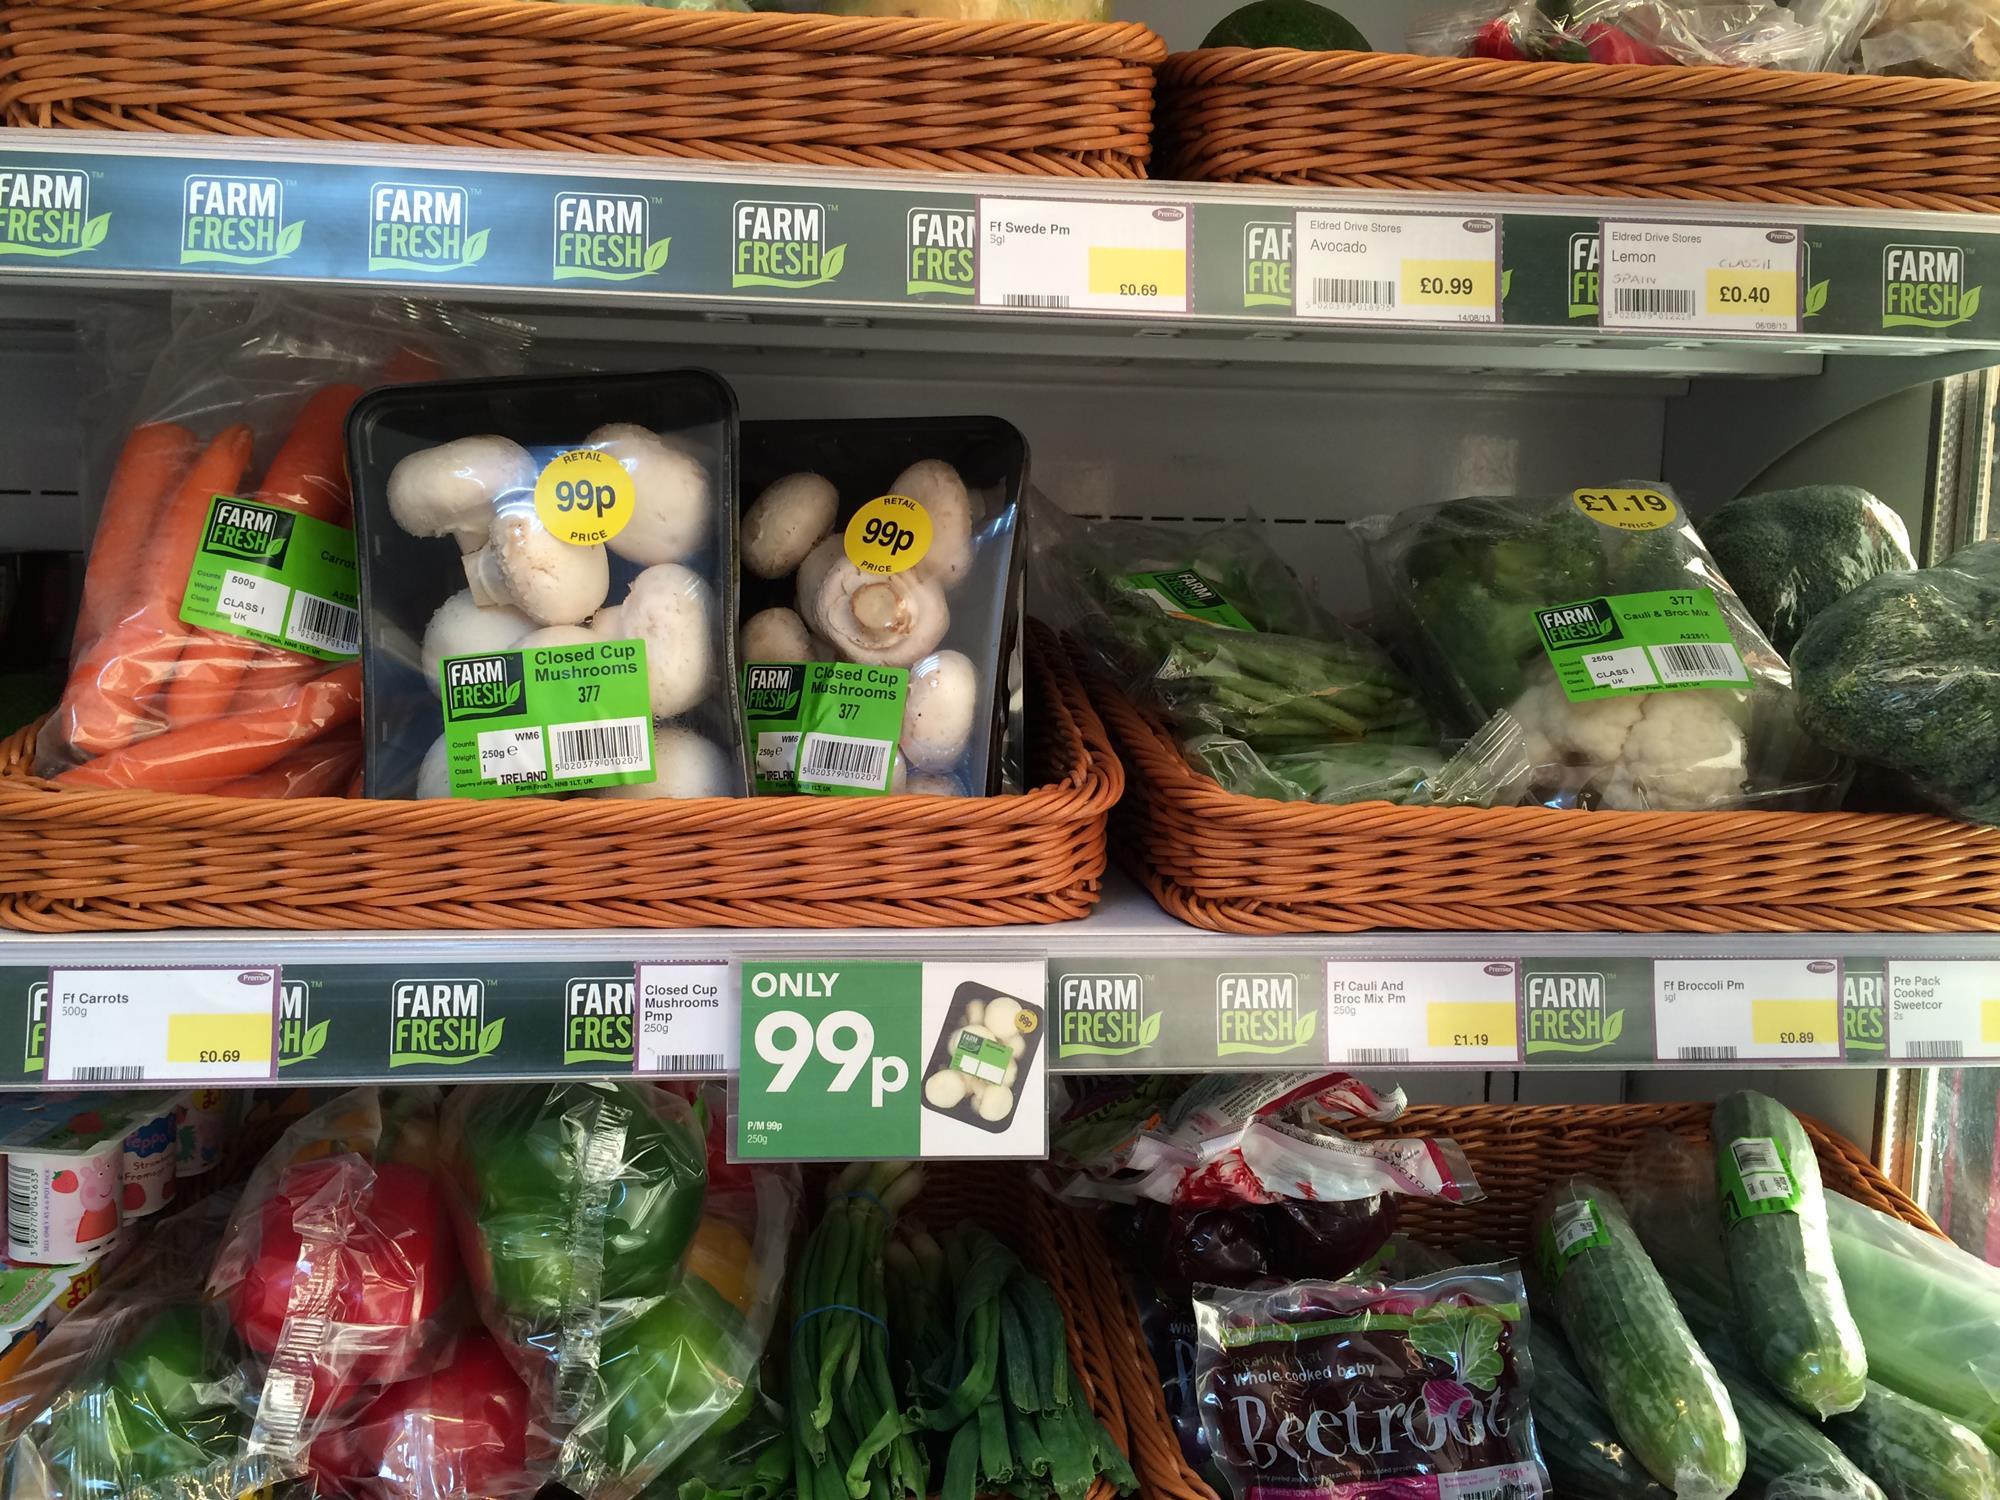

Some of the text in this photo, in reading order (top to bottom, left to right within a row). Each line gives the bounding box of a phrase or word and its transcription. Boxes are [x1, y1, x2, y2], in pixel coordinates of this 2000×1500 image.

[0, 173, 83, 210] FARM
[189, 180, 276, 217] FARM
[375, 188, 461, 225] FARM
[559, 198, 642, 234] FARM
[738, 206, 818, 242] FARM
[0, 208, 80, 244] FRESH
[187, 216, 274, 252] FRESH
[990, 221, 1070, 235] Ff Swede Pm
[1310, 220, 1402, 234] Eldred Drive Stores
[374, 225, 461, 260] FRESH
[989, 234, 1006, 246] Sgl
[1612, 231, 1702, 244] Eldred Drive Stores
[558, 233, 642, 268] FRESH
[1310, 238, 1367, 254] Avocado
[737, 241, 818, 276] FRESH
[911, 247, 974, 282] FRES
[1612, 250, 1656, 263] Lemon
[1887, 250, 1959, 283] FARM
[1119, 283, 1158, 297] £0.69
[1419, 277, 1473, 295] £0.99
[1719, 286, 1770, 303] £0.40
[1886, 283, 1958, 316] FRESH
[563, 451, 603, 464] RETAIL
[555, 479, 616, 518] 99p
[883, 497, 917, 512] RETAIL
[1578, 494, 1668, 512] £1.19
[217, 505, 273, 533] FARM
[1618, 521, 1656, 530] PRICE
[212, 524, 269, 552] FRESH
[570, 529, 608, 543] PRICE
[861, 517, 915, 555] 99p
[860, 559, 893, 573] PRICE
[231, 575, 256, 590] 500g
[1178, 574, 1212, 598] FARM
[223, 597, 259, 613] CLASS
[1669, 596, 1694, 606] 377
[233, 611, 248, 621] UK
[1543, 606, 1593, 629] FARM
[1623, 608, 1711, 621] Cauli & Broc Mix
[1549, 622, 1600, 643] FRESH
[535, 644, 635, 666] Closed Cup
[1592, 655, 1614, 664] 250g
[451, 659, 503, 687] FARM
[535, 661, 638, 682] Mushrooms
[751, 669, 790, 689] FARM
[814, 666, 898, 687] Closed Cup
[1596, 669, 1629, 679] CLASS
[1612, 677, 1625, 685] UK
[453, 681, 505, 708] FRESH
[578, 684, 601, 703] 377
[748, 689, 789, 708] FRESH
[811, 681, 897, 700] Mushrooms
[838, 703, 860, 720] 377
[452, 739, 476, 749] Counts
[515, 731, 540, 742] WM6
[781, 735, 799, 743] WM6
[453, 753, 476, 762] Weight
[482, 749, 505, 760] 250g
[759, 748, 775, 758] 250g
[454, 767, 473, 775] Class
[564, 760, 600, 771] 020379
[604, 757, 639, 766] 010207
[500, 770, 548, 785] IRELAND
[810, 768, 841, 777] 020379
[845, 772, 877, 781] 010207
[242, 973, 271, 982] Premier
[751, 972, 840, 998] ONLY
[1894, 976, 1941, 986] Pre Pack
[645, 984, 718, 998] Closed Cup
[1221, 978, 1292, 1009] FARM
[1334, 980, 1404, 992] Ff Cauli And
[1529, 978, 1599, 1008] FARM
[1664, 981, 1744, 991] Ff Broccoli Pm
[1894, 988, 1934, 998] Cooked
[62, 992, 129, 1004] Ff Carrots
[397, 984, 478, 1018] FARM
[1063, 979, 1137, 1010] FARM
[1334, 993, 1406, 1004] Broc Mix Pm
[645, 997, 719, 1009] Mushrooms
[1893, 1000, 1942, 1010] Sweetcor
[62, 1006, 88, 1018] 500g
[644, 1011, 673, 1023] Pmp
[1333, 1006, 1356, 1017] 250g
[569, 1016, 633, 1049] FRES
[644, 1023, 669, 1035] 250g
[1063, 1010, 1137, 1043] FRESH
[1221, 1010, 1293, 1041] FRESH
[1530, 1009, 1600, 1040] FRESH
[396, 1017, 478, 1052] FRESH
[1454, 1034, 1489, 1046] £1.19
[1780, 1032, 1814, 1044] £0.89
[199, 1050, 241, 1063] £0.69
[754, 1010, 909, 1108] 99p
[747, 1121, 783, 1132] P/M 99p
[747, 1135, 768, 1146] 250g
[1233, 1362, 1375, 1387] Whole cooked baby
[1230, 1386, 1511, 1469] Beetroot
